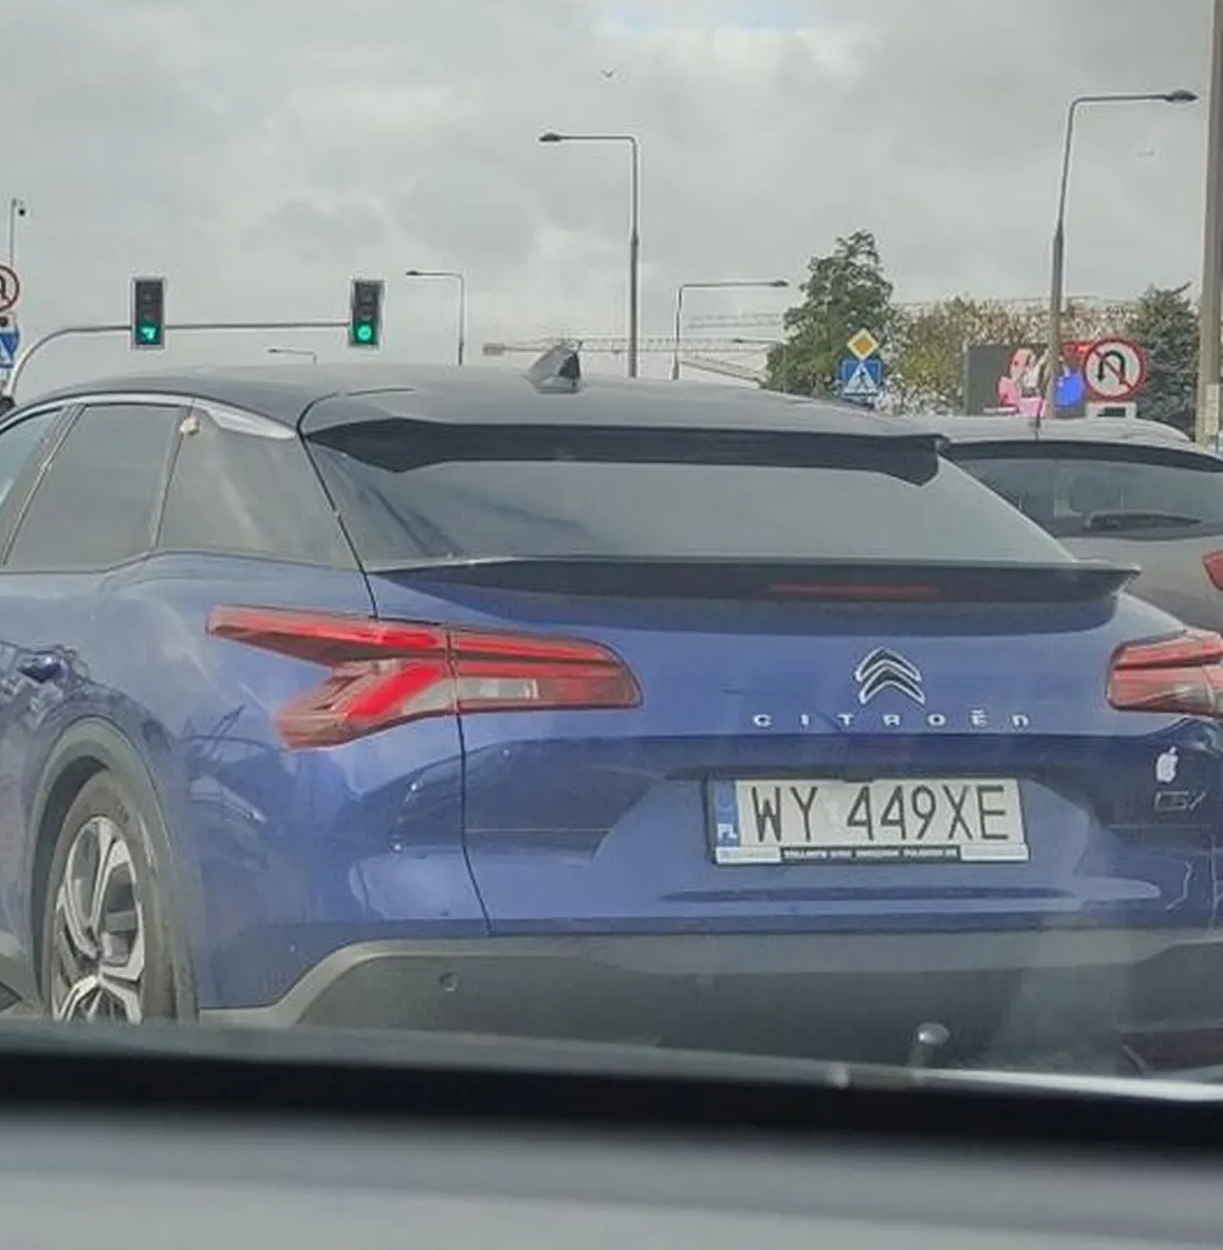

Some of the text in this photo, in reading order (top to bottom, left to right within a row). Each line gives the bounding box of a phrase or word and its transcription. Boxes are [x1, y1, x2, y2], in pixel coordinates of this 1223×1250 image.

[717, 823, 738, 841] PL
[751, 784, 1009, 843] WY 449XE
